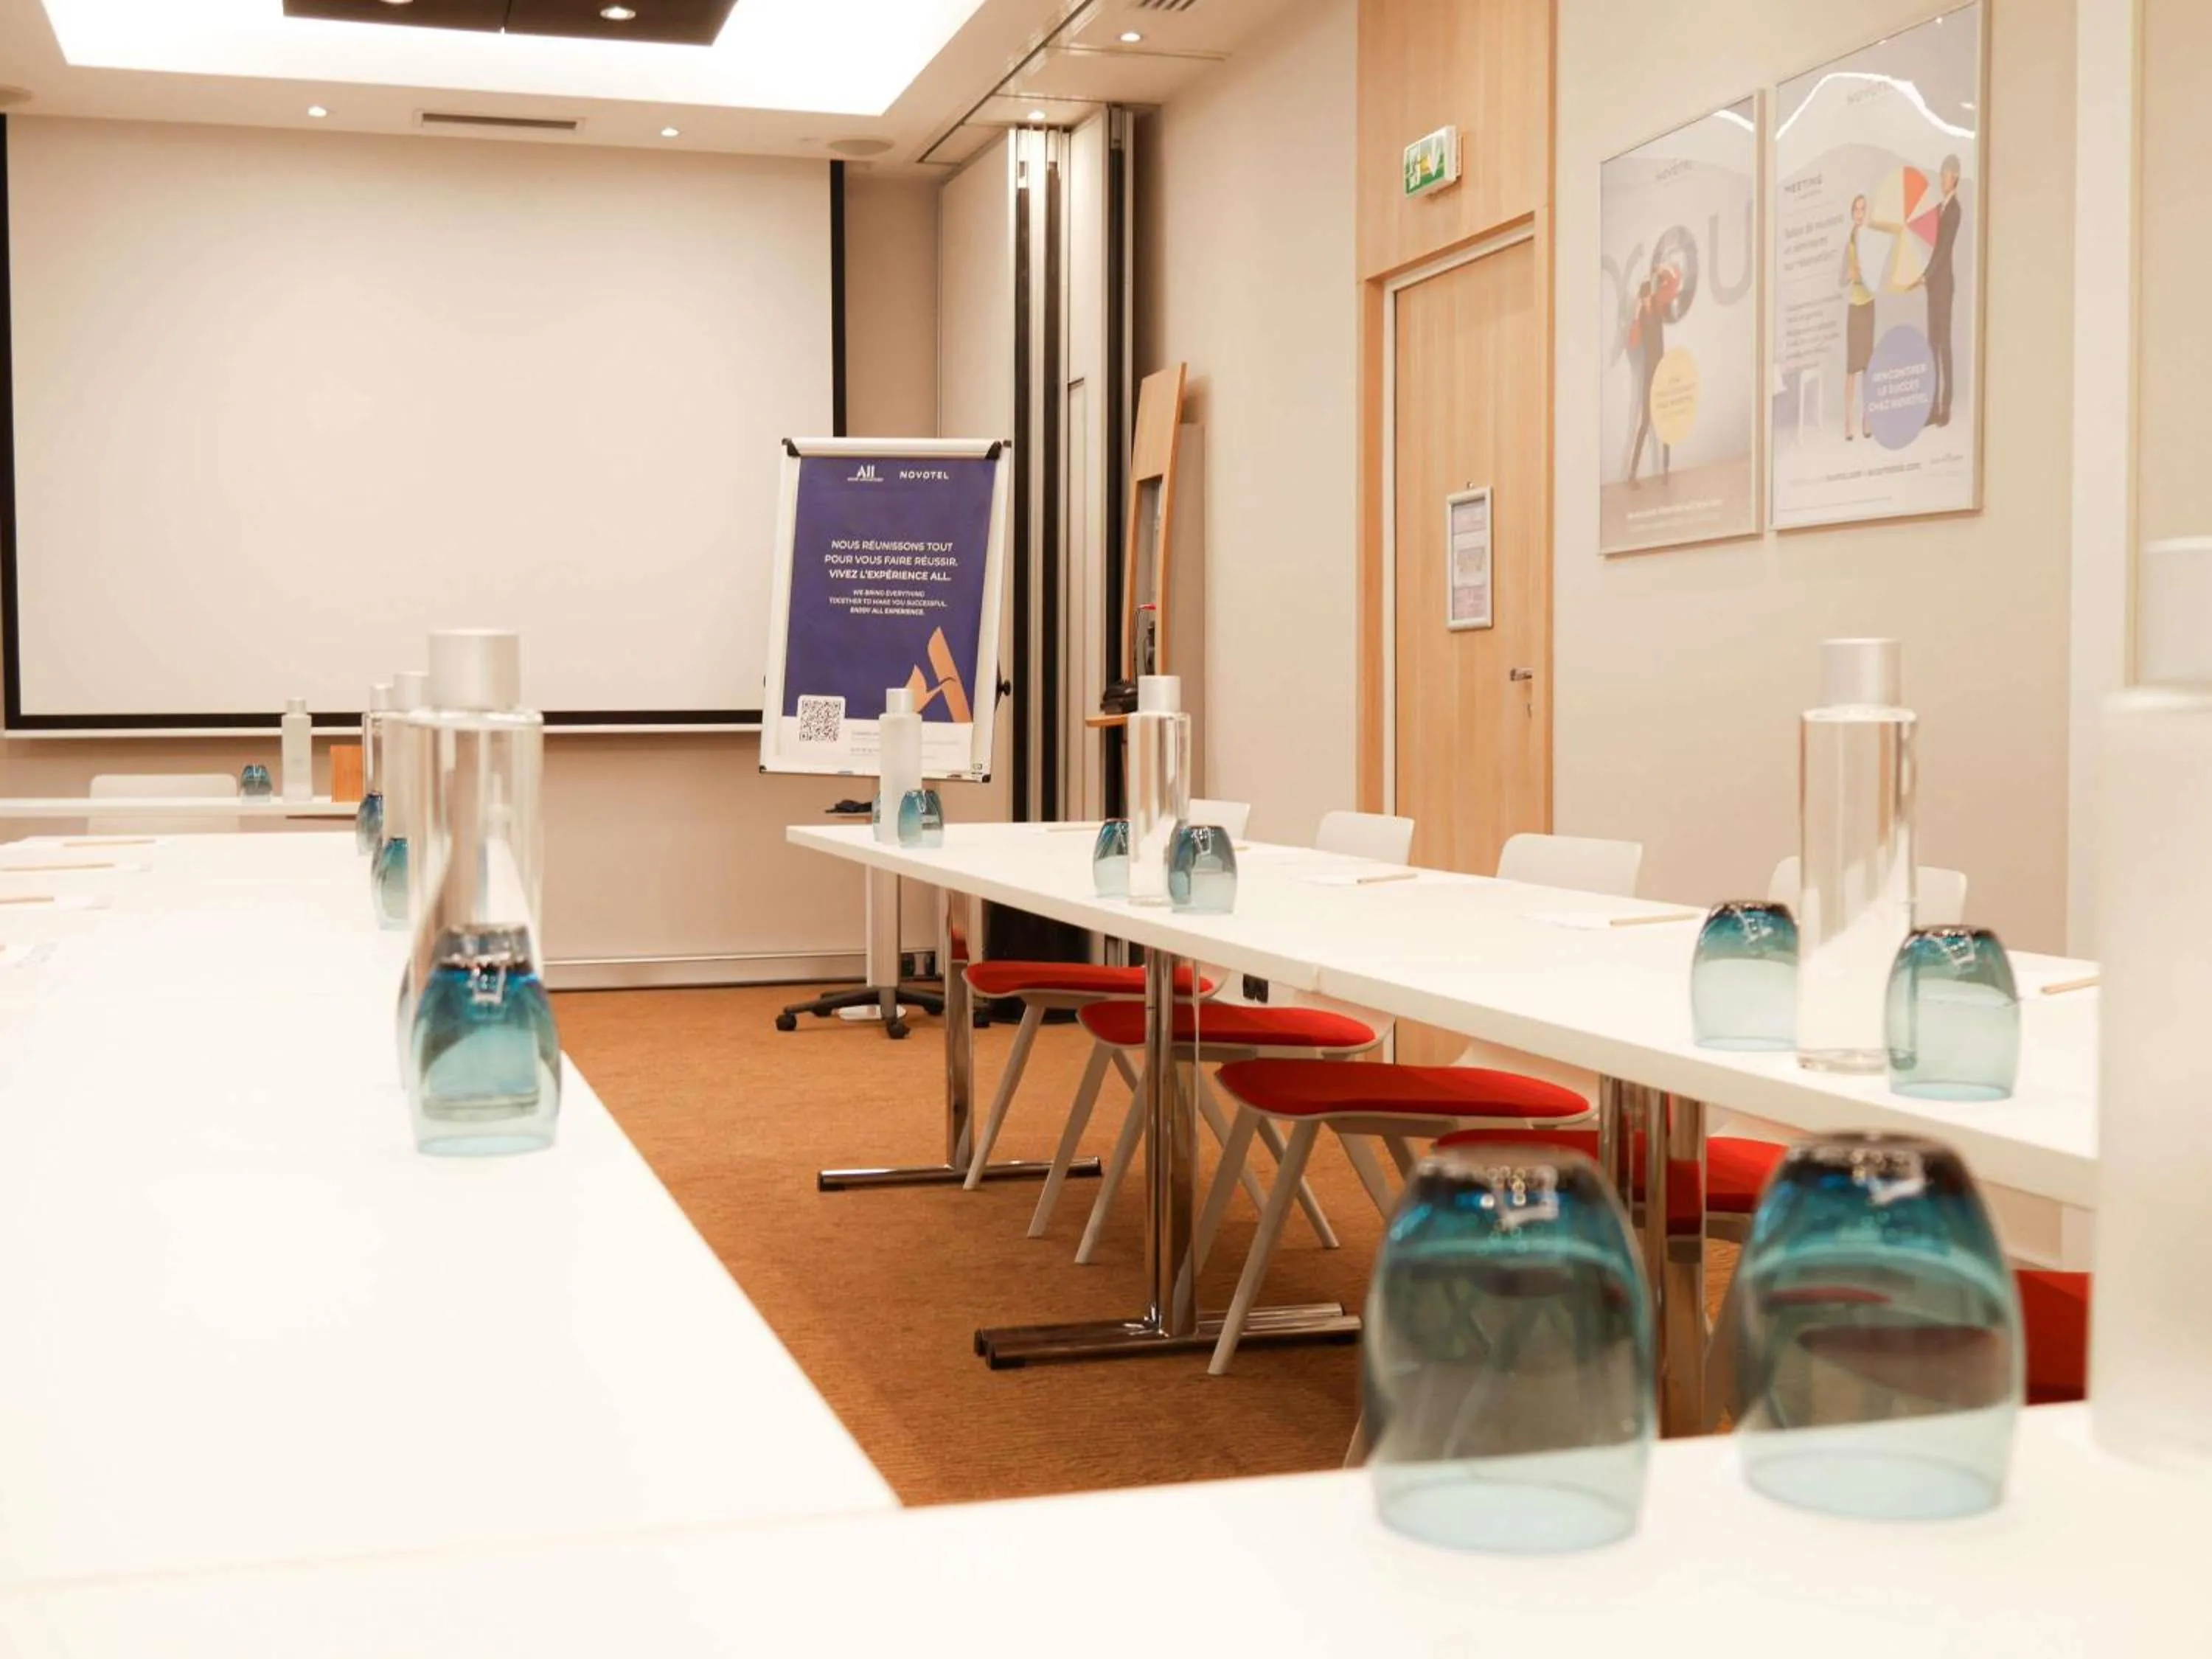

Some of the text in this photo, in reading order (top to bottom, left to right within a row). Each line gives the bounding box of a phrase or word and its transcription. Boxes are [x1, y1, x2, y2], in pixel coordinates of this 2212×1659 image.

[899, 470, 949, 480] NOVOTEL
[831, 540, 953, 552] NOUS RÉUNISSONS TOUT
[824, 554, 959, 566] POUR VOUS FAIRE RÉUSSIR.
[829, 569, 952, 581] VIVEZ L'EXPÉRIENCE ALL.
[829, 597, 862, 605] TOGETHER
